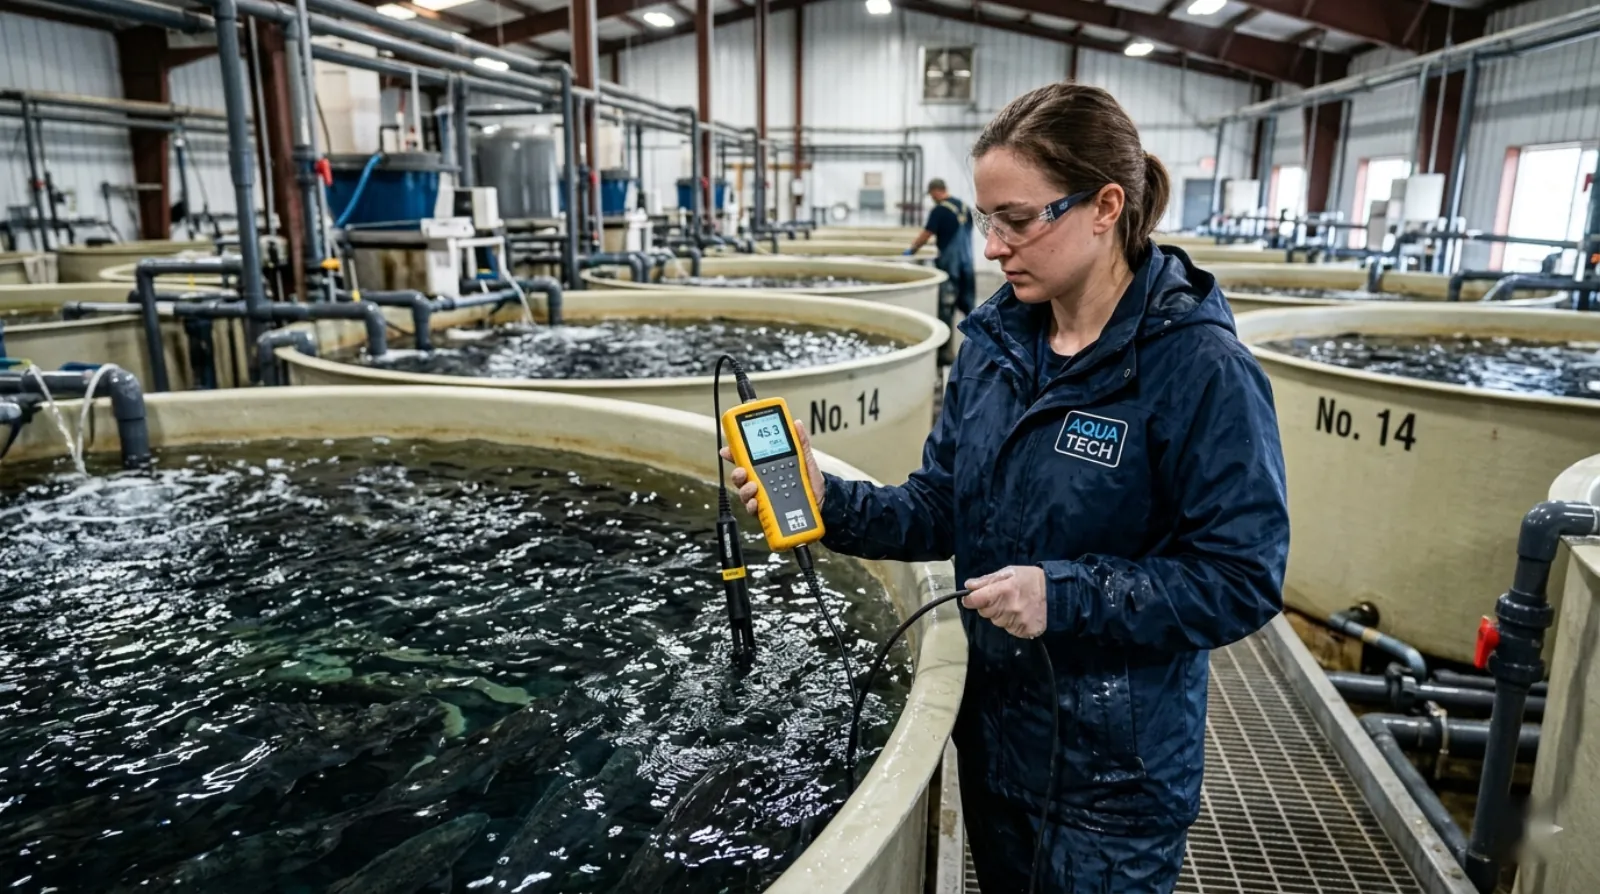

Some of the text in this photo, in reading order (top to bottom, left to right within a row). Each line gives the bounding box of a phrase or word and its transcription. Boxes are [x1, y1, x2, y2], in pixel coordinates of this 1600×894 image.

[811, 387, 879, 435] No. 14
[1316, 396, 1417, 452] No. 14
[757, 424, 780, 438] 45.3
[1067, 418, 1118, 443] AQUA
[1066, 433, 1114, 460] TECH
